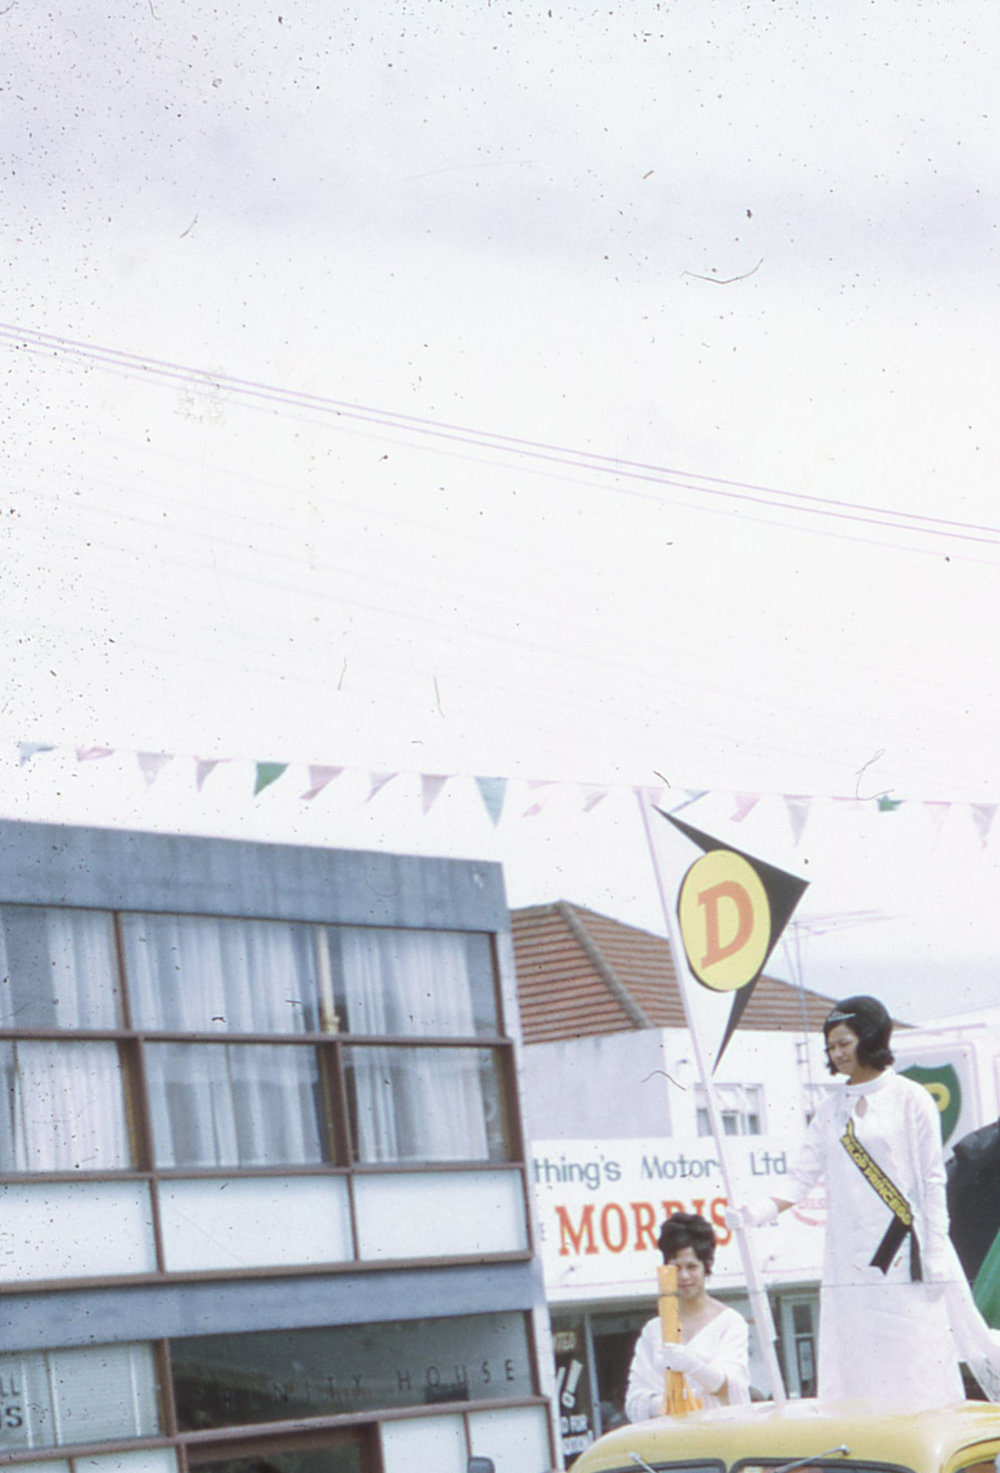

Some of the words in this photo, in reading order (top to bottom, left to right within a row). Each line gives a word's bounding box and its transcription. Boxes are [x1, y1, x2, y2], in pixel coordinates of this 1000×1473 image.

[697, 880, 755, 971] D
[750, 1151, 787, 1176] Ltd
[555, 1197, 731, 1256] MORS
[396, 1358, 515, 1391] HOUSE
